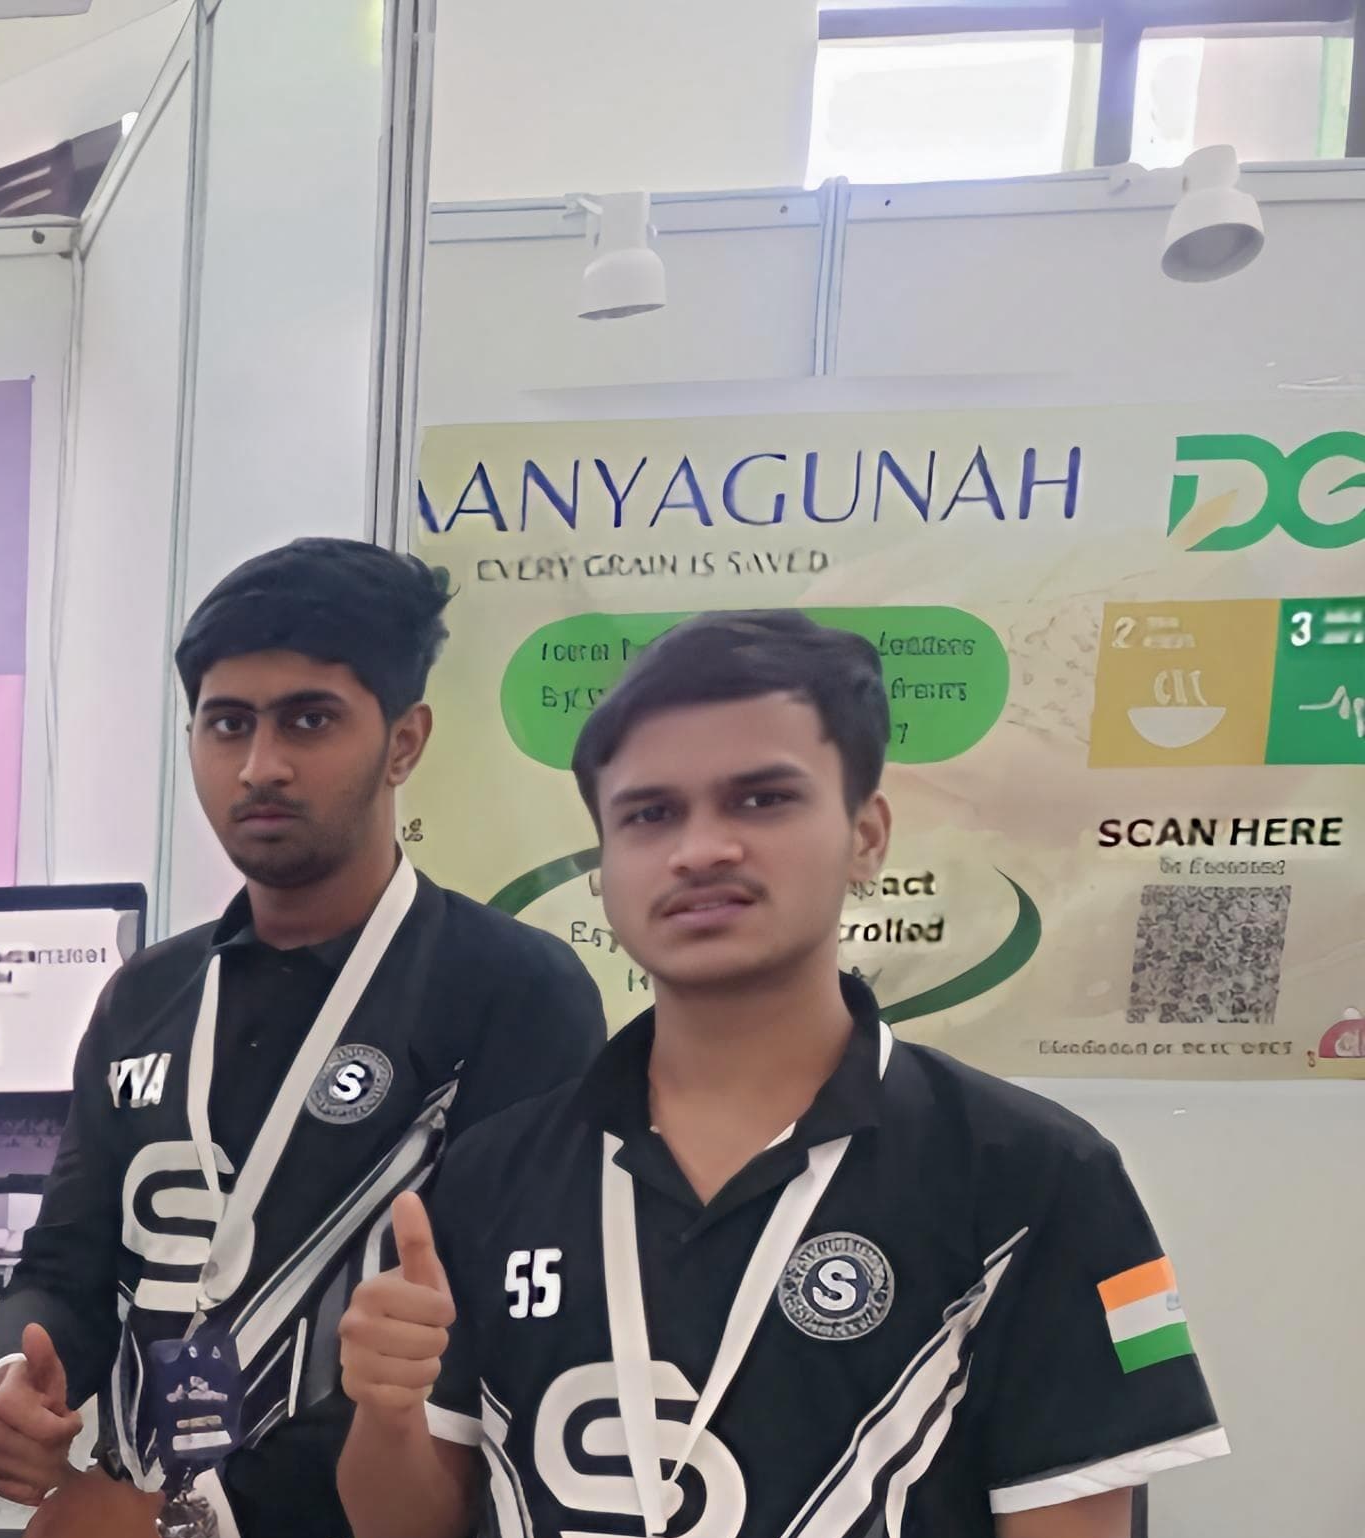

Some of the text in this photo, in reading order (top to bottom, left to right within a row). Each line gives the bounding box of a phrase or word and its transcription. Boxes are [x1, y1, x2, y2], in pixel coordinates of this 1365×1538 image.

[476, 548, 830, 582] EVERY GRAIN IS SAVED
[1098, 817, 1343, 847] SCAN HERE
